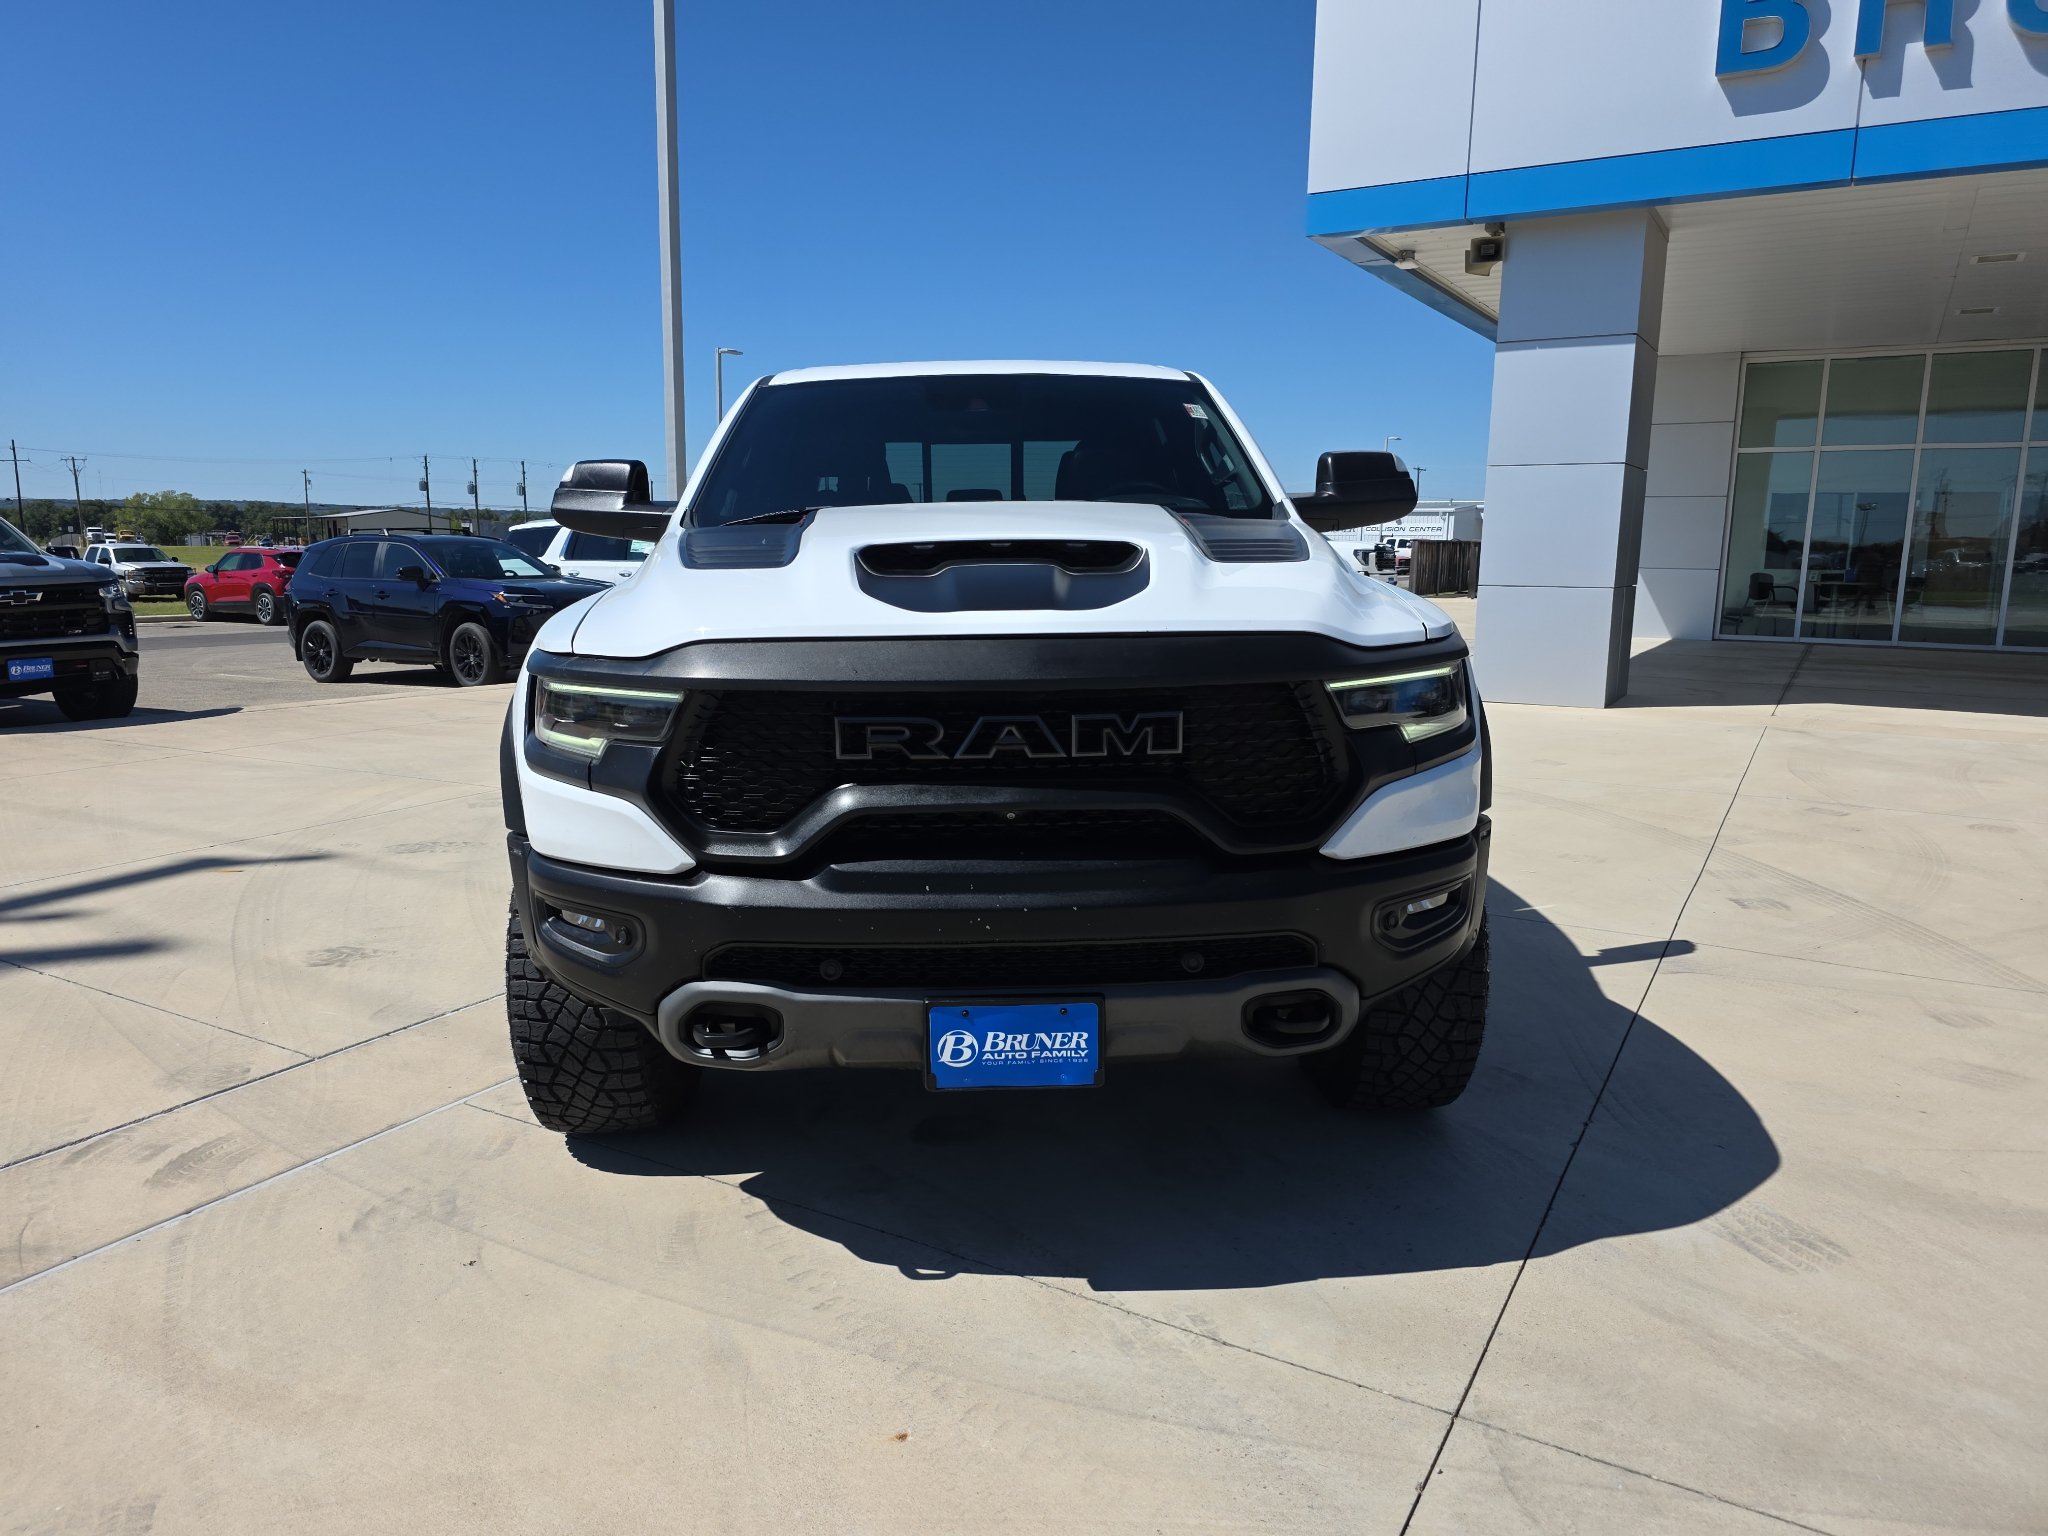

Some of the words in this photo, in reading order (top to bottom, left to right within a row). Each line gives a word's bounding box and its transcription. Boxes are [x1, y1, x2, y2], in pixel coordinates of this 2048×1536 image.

[834, 710, 1185, 760] RAM
[937, 1033, 975, 1063] B
[981, 1031, 1089, 1051] BRUNER
[982, 1051, 1028, 1060] AUTO
[1031, 1049, 1089, 1058] FAMILY
